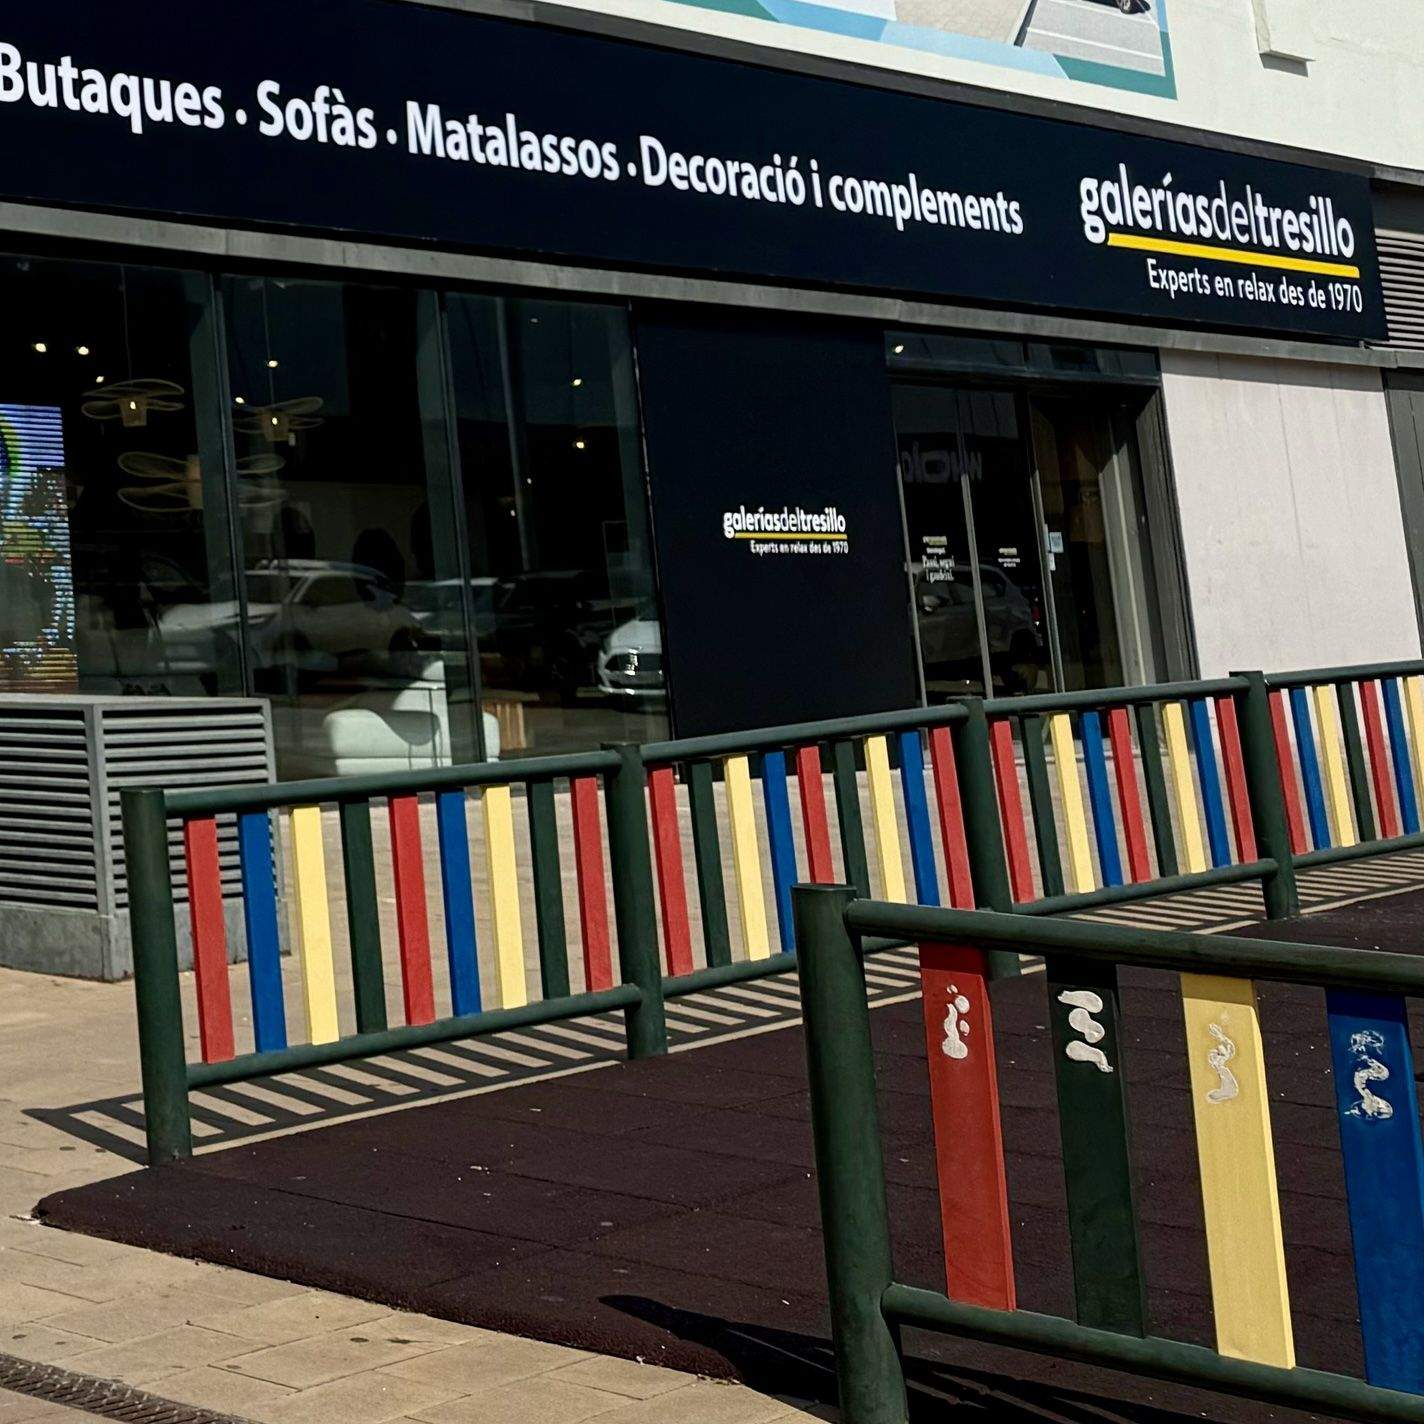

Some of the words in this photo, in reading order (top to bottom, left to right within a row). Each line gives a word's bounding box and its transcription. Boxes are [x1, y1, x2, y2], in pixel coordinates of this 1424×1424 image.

[257, 79, 378, 149] Sofàs
[405, 100, 619, 181] Matalassos
[639, 135, 806, 205] Decoració
[810, 159, 823, 208] i
[828, 173, 1024, 235] complements
[1080, 163, 1354, 258] galeríasdeltresillo
[1147, 258, 1210, 299] Experts
[1215, 277, 1235, 298] en
[1237, 274, 1275, 304] relax
[1279, 279, 1304, 306] des
[1308, 280, 1325, 309] de
[1328, 283, 1363, 313] 1970
